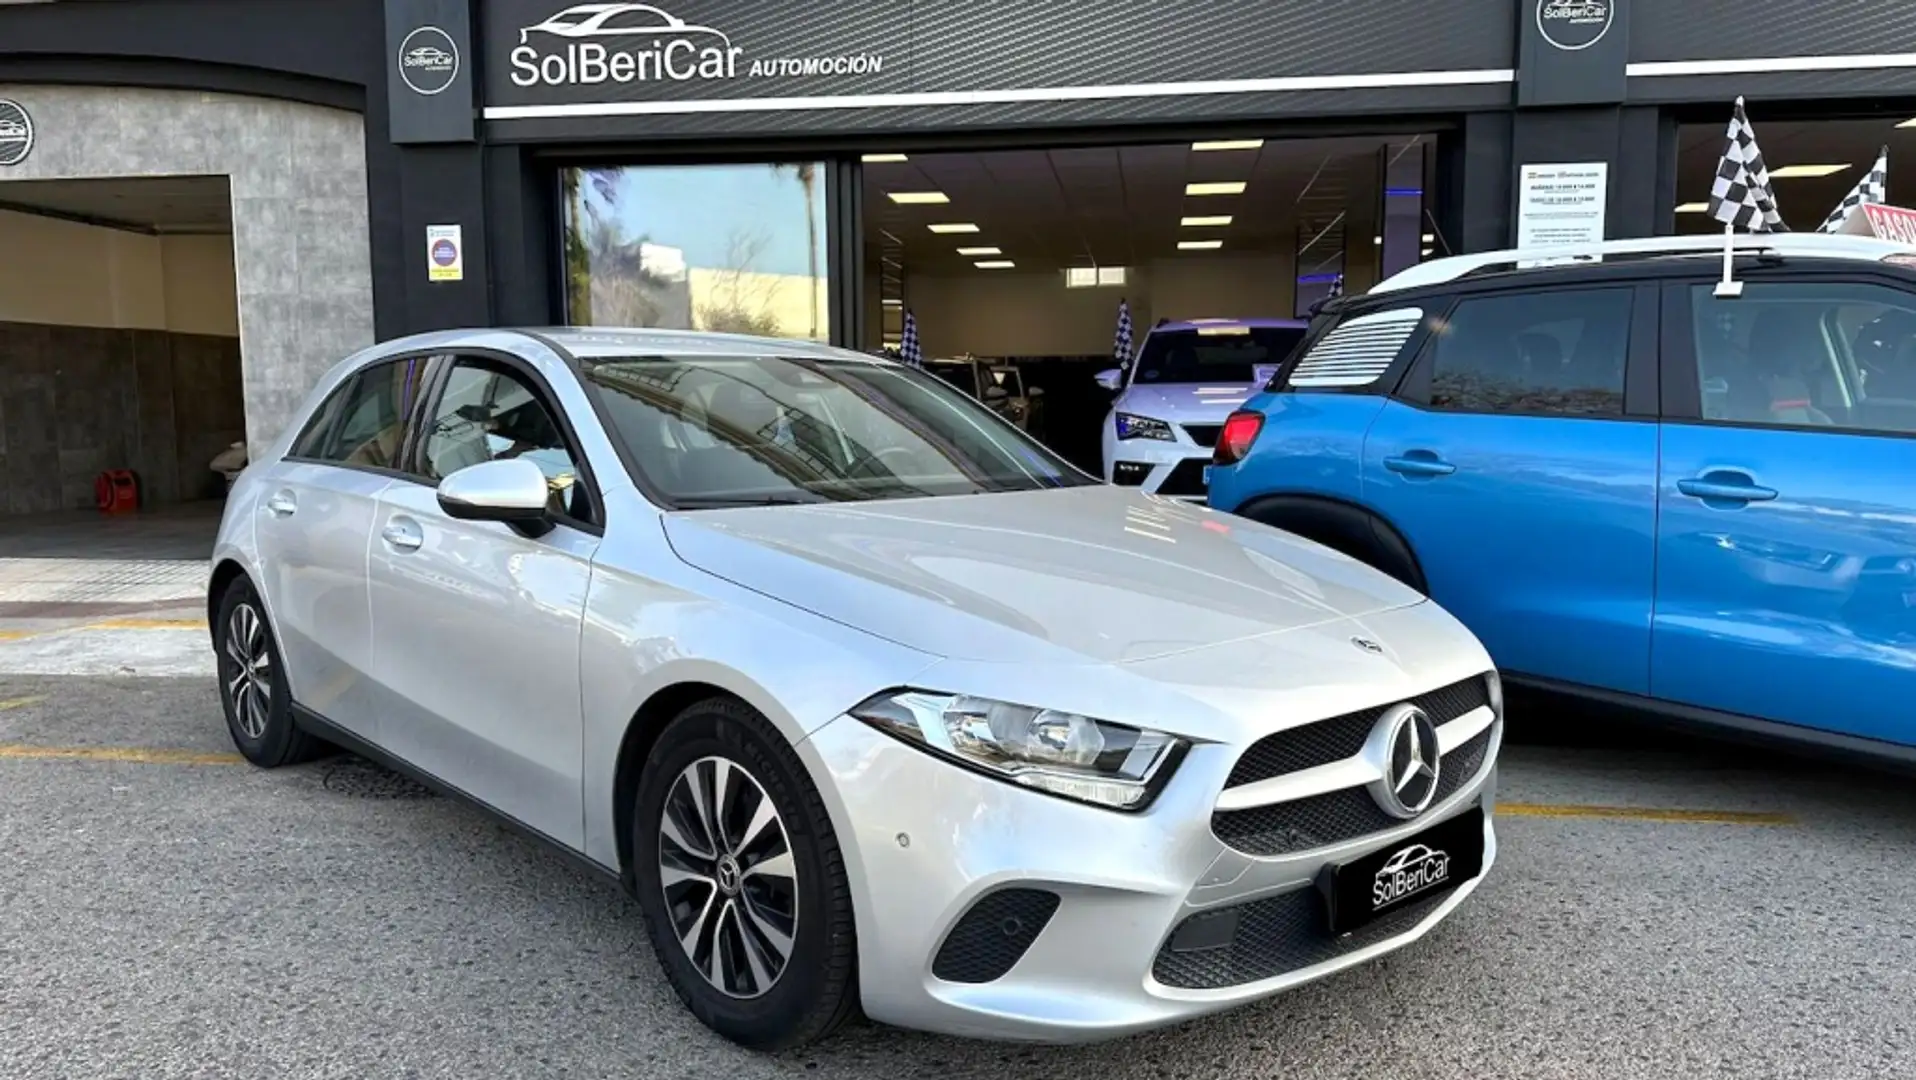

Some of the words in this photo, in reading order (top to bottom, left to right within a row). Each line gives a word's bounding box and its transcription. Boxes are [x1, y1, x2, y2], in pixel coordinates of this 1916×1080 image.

[510, 39, 743, 86] SolBeriCar
[749, 52, 883, 77] AUTOMOCIÓN
[1870, 207, 1916, 245] GASO
[1373, 857, 1451, 905] SolBeriCar
